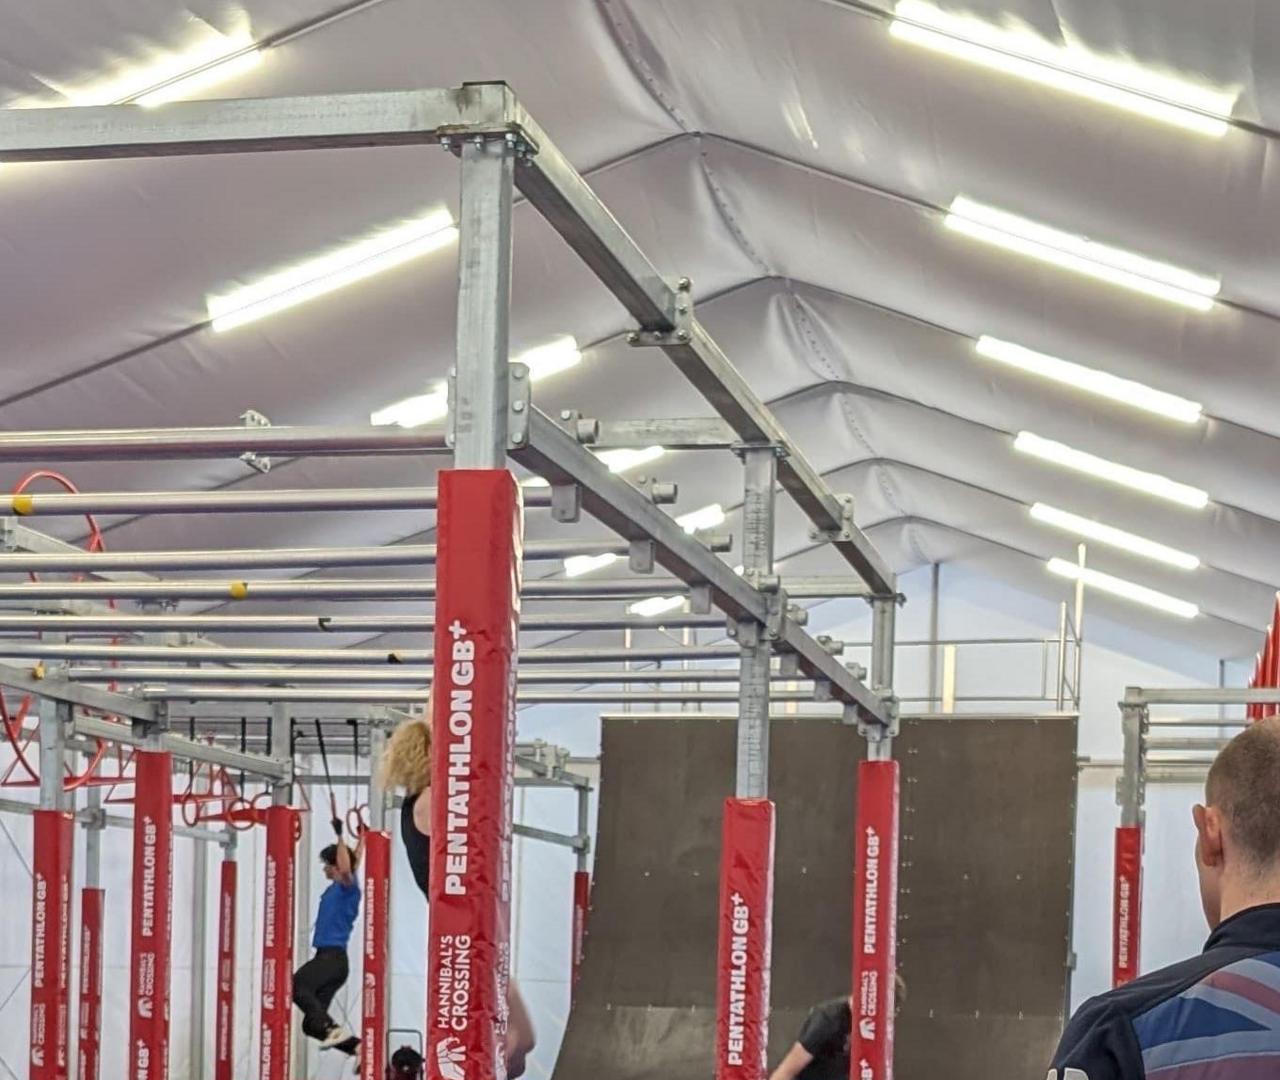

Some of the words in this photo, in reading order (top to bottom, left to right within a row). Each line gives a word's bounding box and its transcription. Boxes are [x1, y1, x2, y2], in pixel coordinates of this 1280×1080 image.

[445, 691, 472, 896] PENTATHLON
[142, 847, 155, 936] PENTATHLON
[864, 859, 878, 954] PENTATHLON
[34, 902, 45, 988] PENTATHLON
[438, 935, 453, 1028] HANNIBAL'S
[451, 934, 470, 1031] CROSSING
[728, 936, 747, 1066] PENTATHLON
